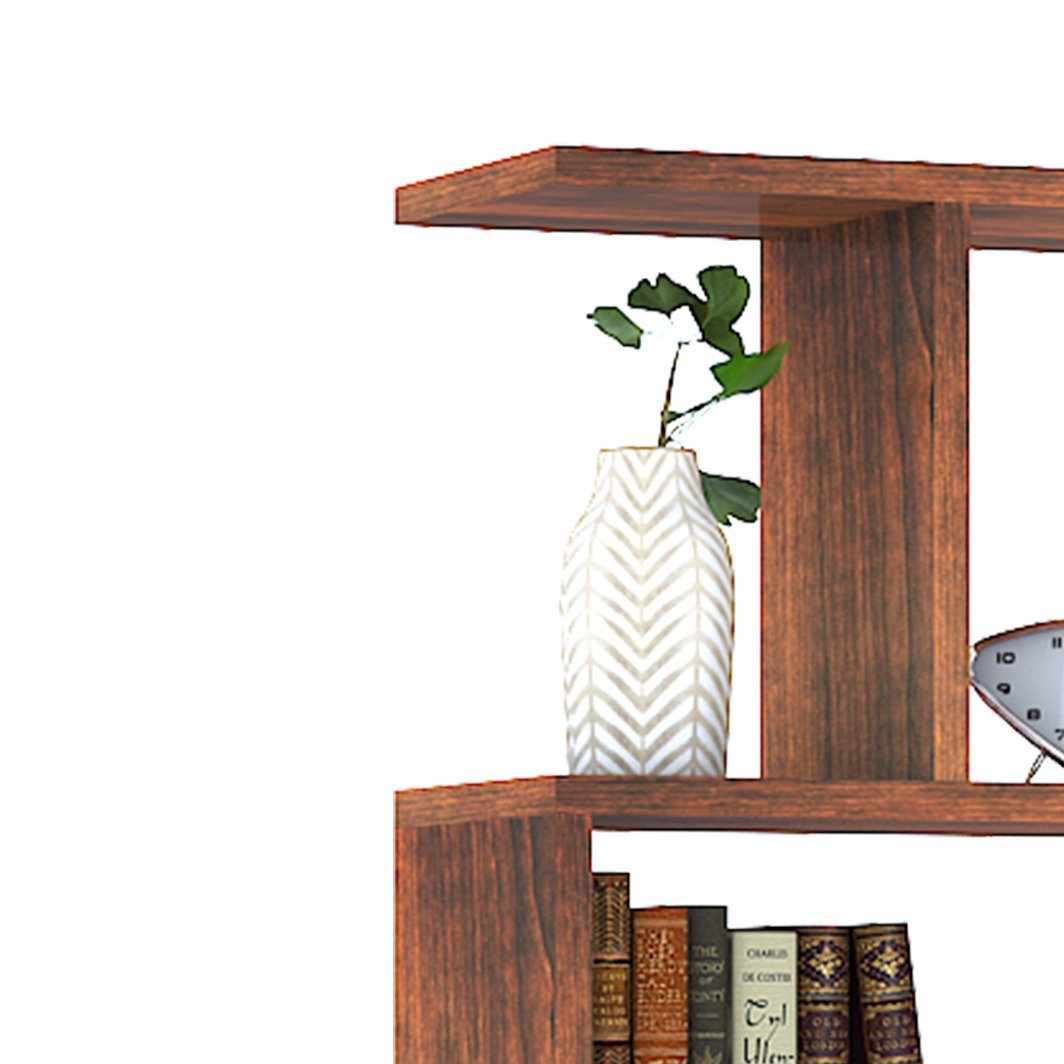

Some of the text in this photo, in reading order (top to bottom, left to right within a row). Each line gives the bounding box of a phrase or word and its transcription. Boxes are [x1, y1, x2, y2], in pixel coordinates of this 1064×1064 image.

[1052, 637, 1062, 649] 11
[997, 652, 1016, 664] 10
[997, 682, 1011, 695] 9
[1027, 708, 1041, 720] 8
[743, 973, 756, 983] DE
